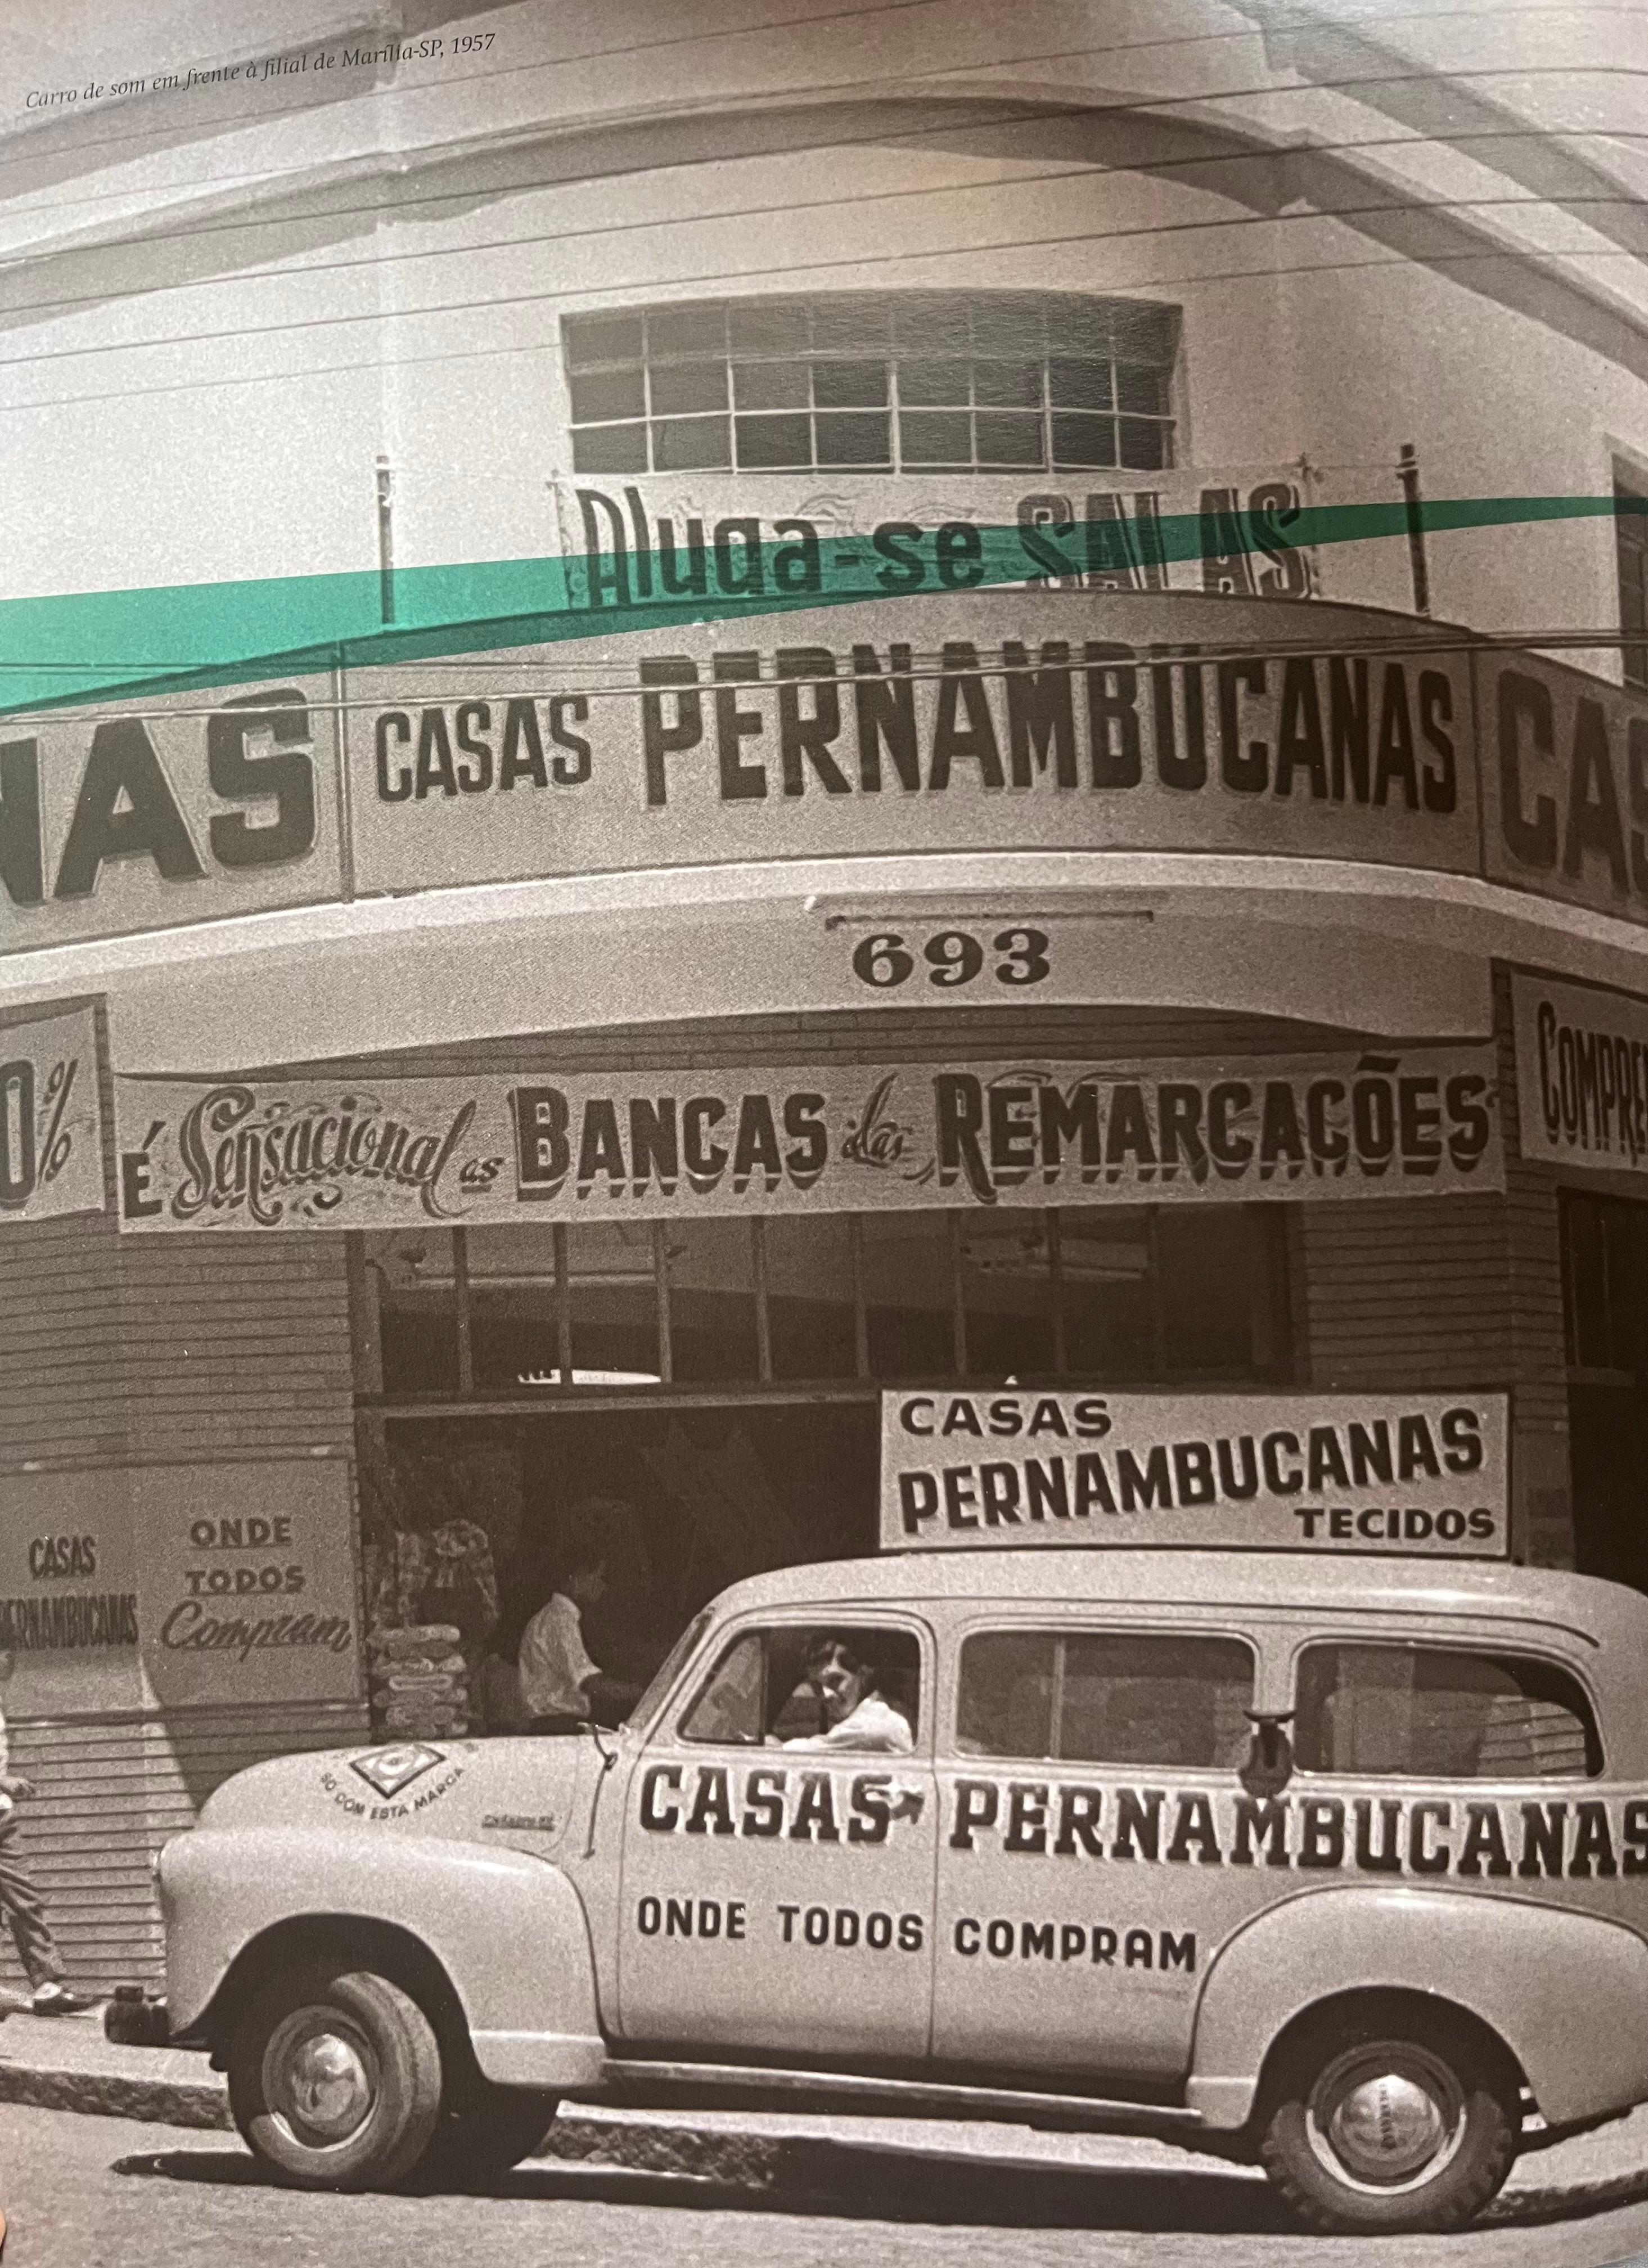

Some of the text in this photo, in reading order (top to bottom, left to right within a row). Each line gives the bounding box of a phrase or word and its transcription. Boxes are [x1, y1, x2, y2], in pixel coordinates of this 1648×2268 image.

[375, 641, 1456, 814] CASAS PERNAMBUCANAS
[852, 928, 1052, 989] 693
[1538, 1000, 1648, 1167] COMPRE
[119, 1120, 168, 1220] É
[171, 1086, 477, 1226] Sensacional
[459, 1155, 505, 1185] as
[507, 1086, 828, 1202] BANCAS
[900, 1397, 1112, 1438] CASAS
[900, 1408, 1483, 1534] PERNAMBUCANAS
[29, 1534, 96, 1578] CASAS
[190, 1517, 292, 1547] ONDE
[1294, 1507, 1496, 1540] TECIDOS
[186, 1565, 307, 1595] TODOS
[638, 1763, 1648, 1878] CASAS PERNAMBUCANAS
[638, 1894, 1197, 1973] ONDE TODOS COMPRAM
